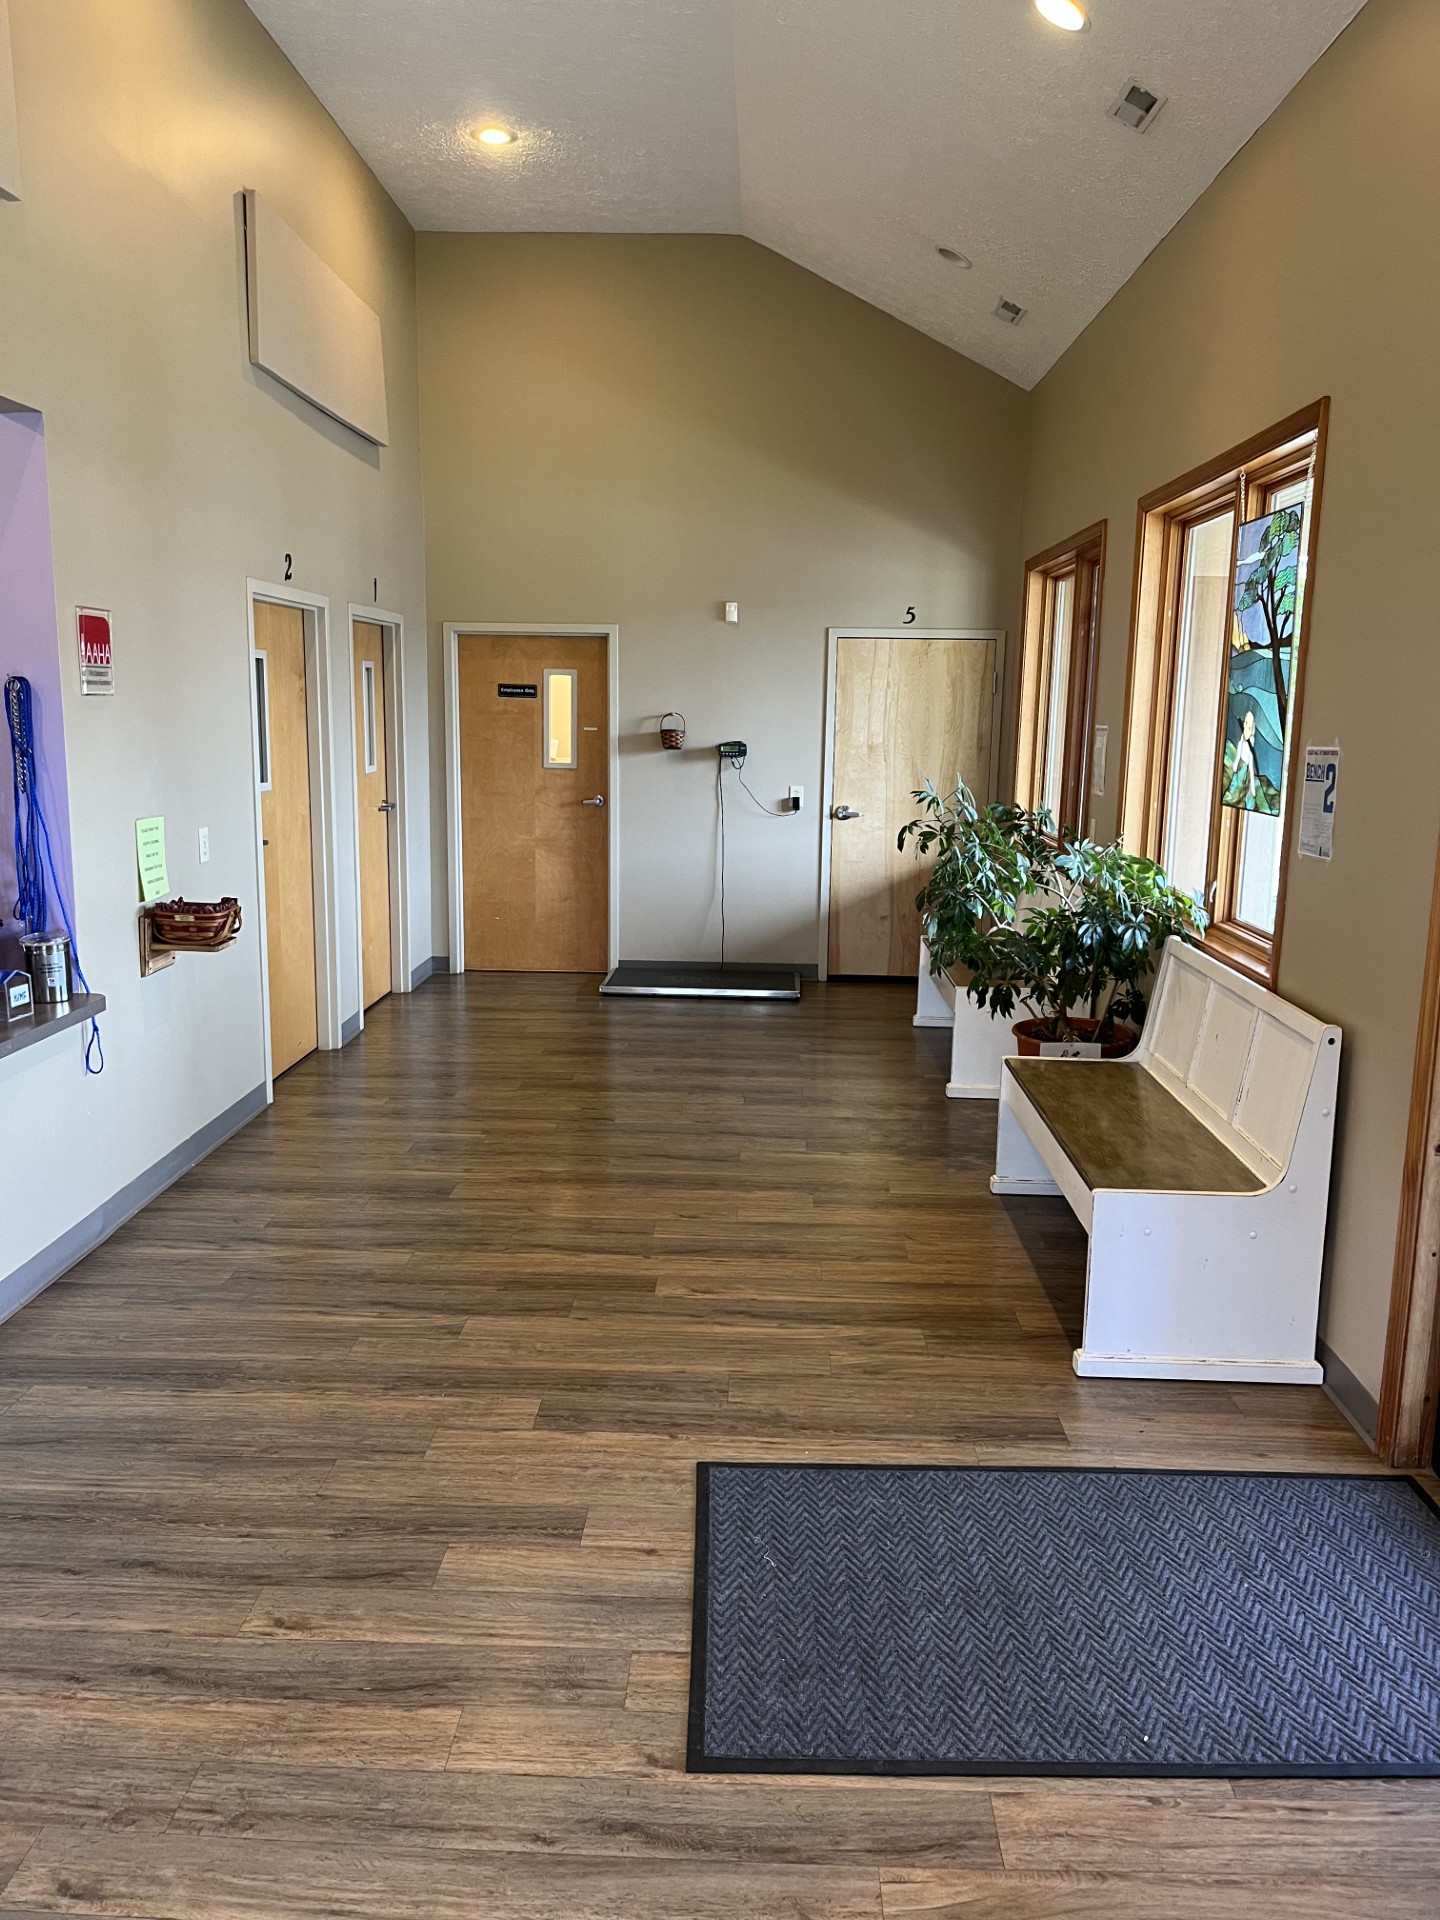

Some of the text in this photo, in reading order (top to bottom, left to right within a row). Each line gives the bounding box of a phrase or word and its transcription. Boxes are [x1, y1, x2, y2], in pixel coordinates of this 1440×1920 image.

[285, 553, 292, 581] 2
[374, 577, 378, 602] 1
[903, 606, 916, 624] 5
[86, 642, 111, 665] AAHA
[1306, 763, 1325, 780] BENCH
[1323, 763, 1336, 813] 2
